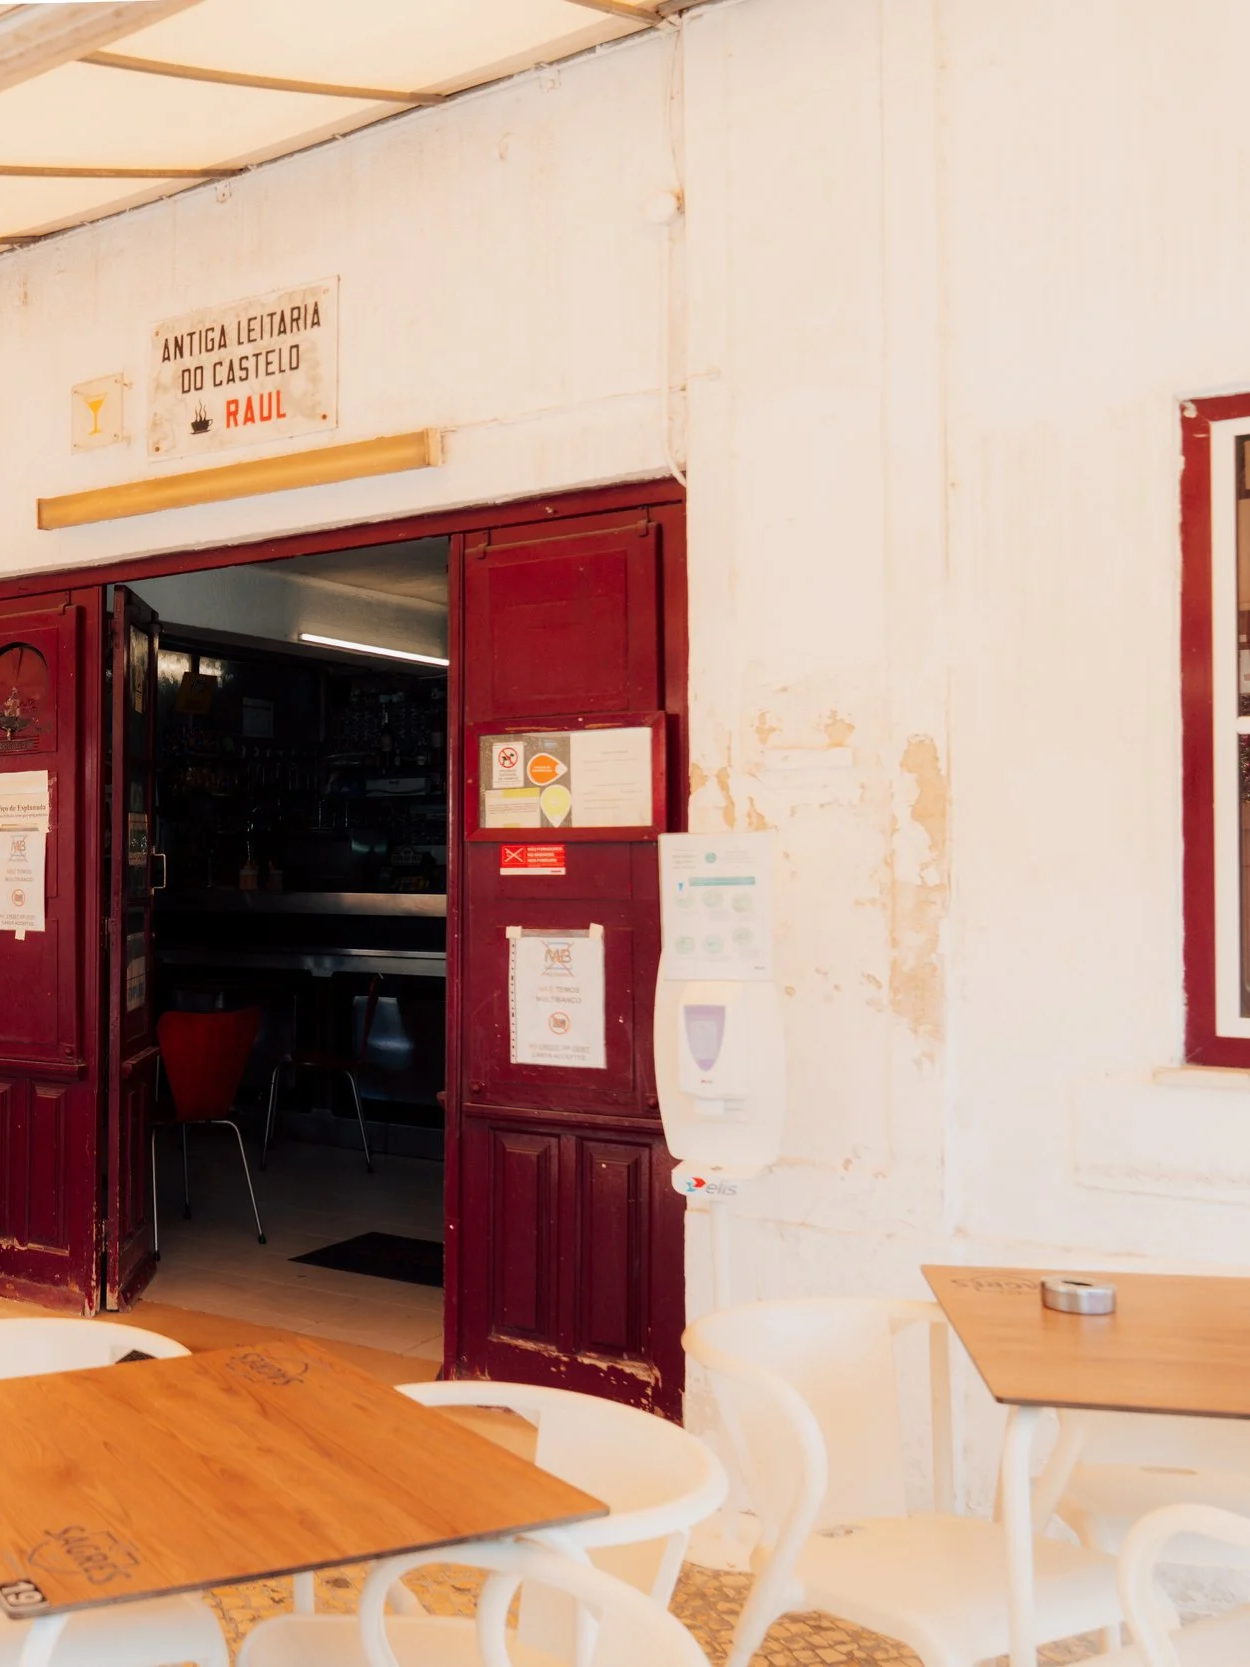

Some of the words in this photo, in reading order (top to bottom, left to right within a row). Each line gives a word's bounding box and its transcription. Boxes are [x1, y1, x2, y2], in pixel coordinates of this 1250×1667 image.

[161, 324, 228, 364] ANTIGA
[237, 300, 321, 346] LEITARIA
[181, 365, 204, 395] DO
[213, 344, 300, 388] CASTELO
[225, 389, 287, 430] RAUL
[17, 803, 47, 813] Esplanada
[705, 1179, 737, 1196] elis
